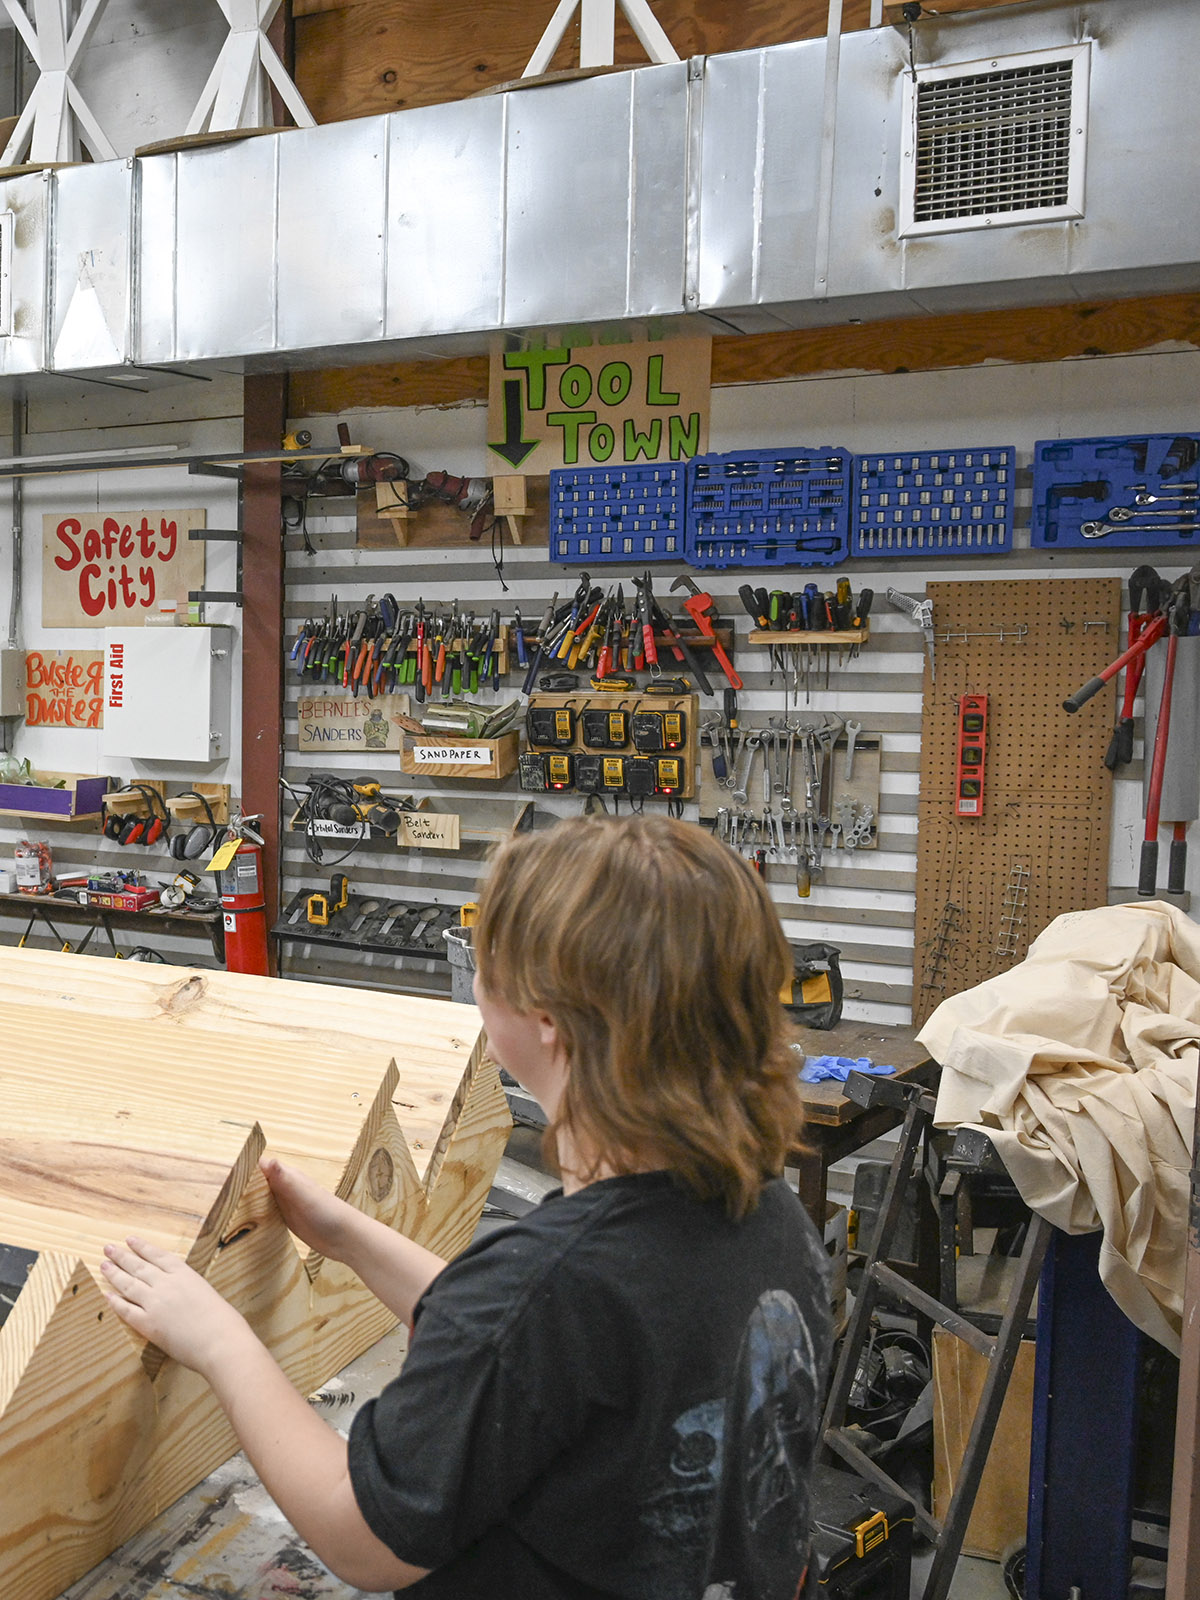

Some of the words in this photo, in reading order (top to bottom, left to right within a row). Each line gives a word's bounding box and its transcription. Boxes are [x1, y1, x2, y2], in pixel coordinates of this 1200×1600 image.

[503, 348, 681, 411] TOOL
[546, 411, 700, 464] TOWN
[54, 517, 177, 571] Safety
[79, 563, 156, 616] City
[109, 644, 124, 669] Aid
[49, 687, 75, 697] THE
[109, 674, 124, 708] First
[301, 700, 372, 719] BERNIE'S
[302, 724, 362, 742] SANDERS
[420, 749, 481, 760] SANDPAPER
[404, 816, 430, 828] Belt
[412, 830, 445, 840] Sanders
